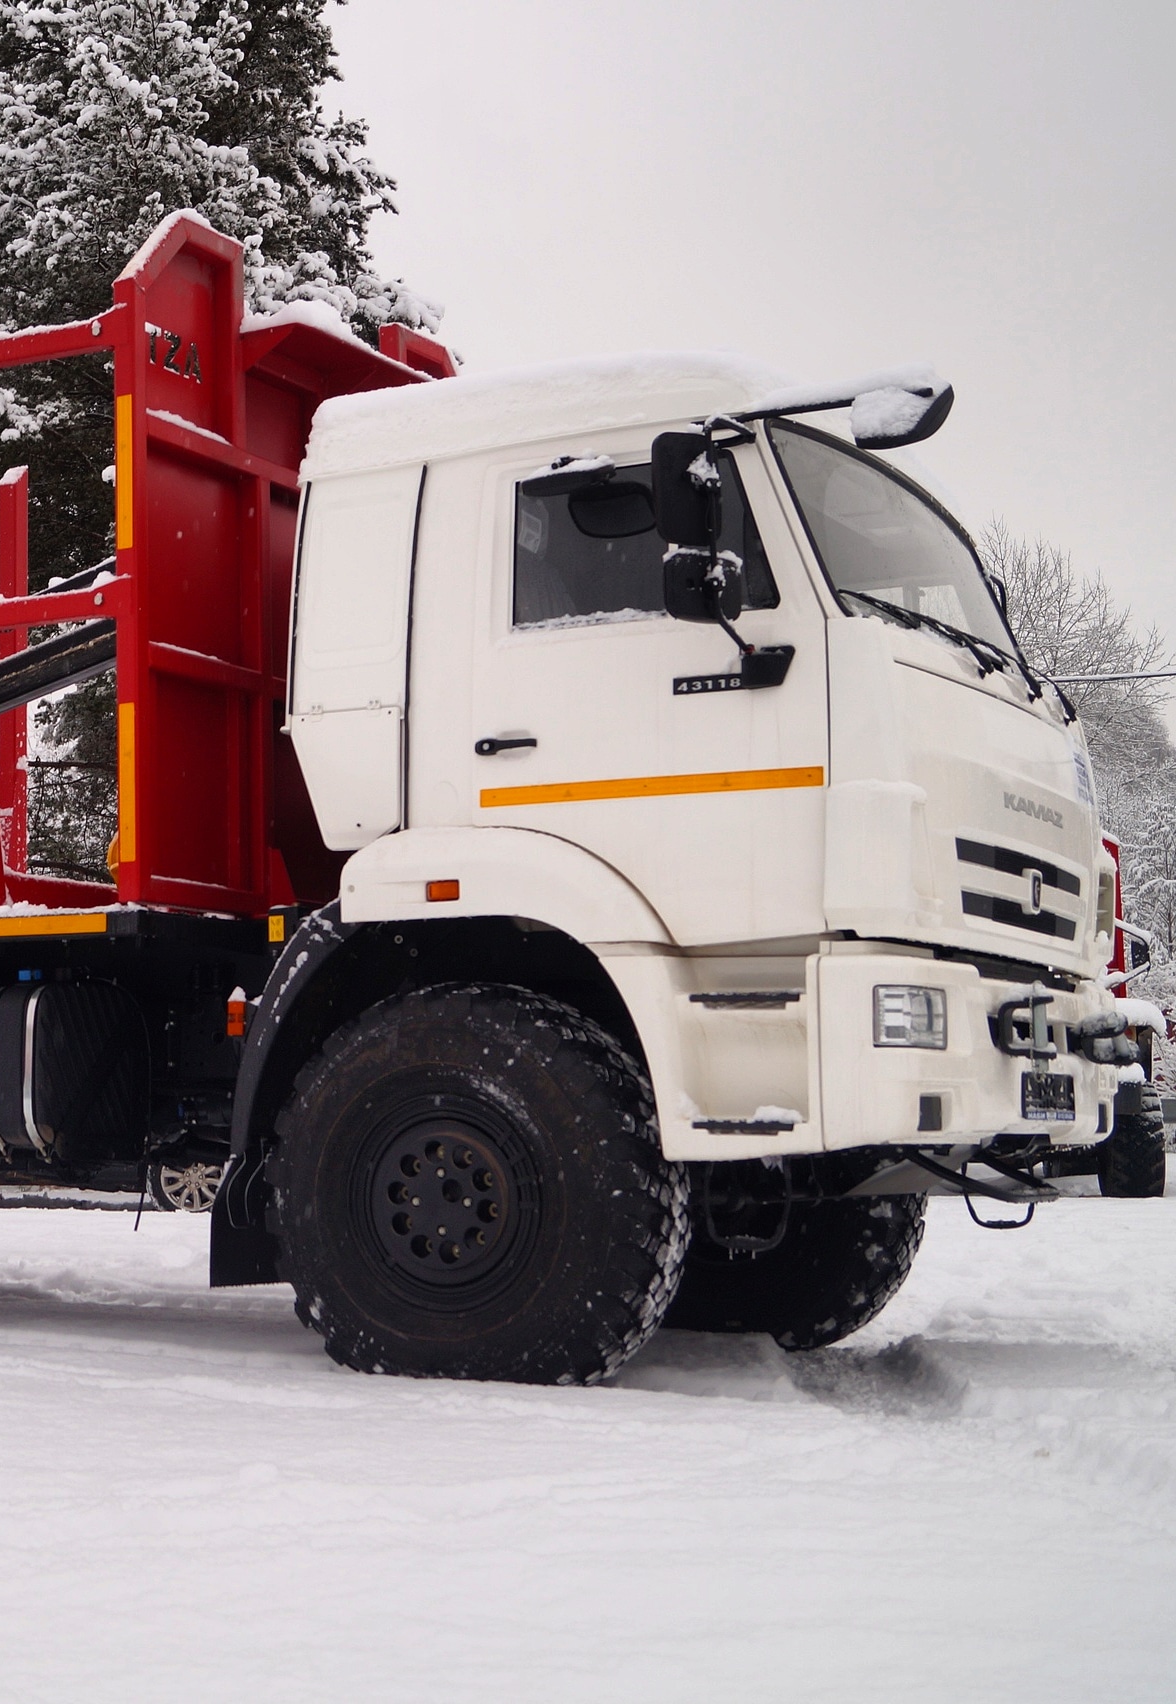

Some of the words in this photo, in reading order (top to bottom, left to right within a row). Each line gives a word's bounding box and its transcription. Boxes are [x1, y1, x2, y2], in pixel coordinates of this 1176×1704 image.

[144, 321, 202, 384] TZA
[677, 677, 741, 692] 43118
[1003, 791, 1064, 829] KAMAZ
